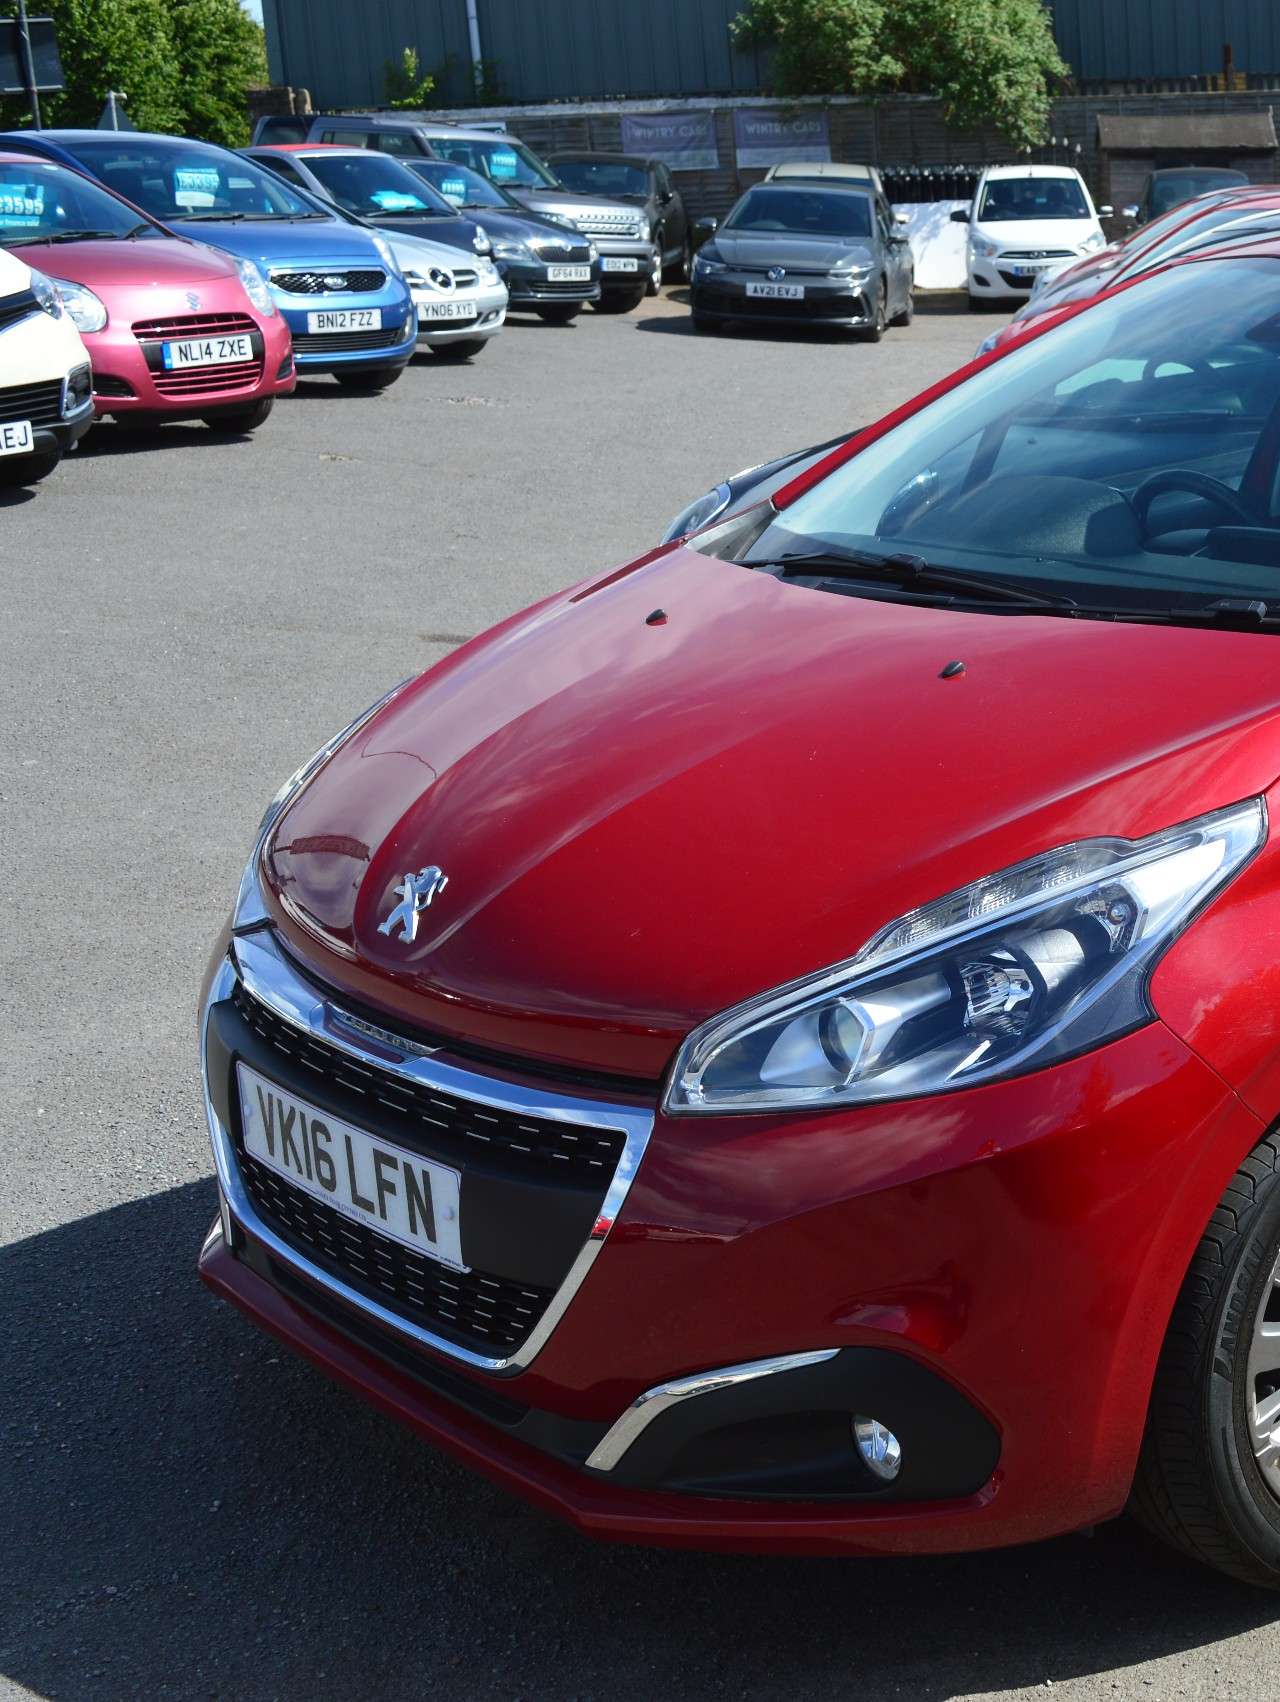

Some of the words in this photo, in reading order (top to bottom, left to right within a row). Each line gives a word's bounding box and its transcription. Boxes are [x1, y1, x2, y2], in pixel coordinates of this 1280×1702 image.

[752, 284, 776, 296] AV21
[777, 286, 798, 297] EVJ
[317, 313, 346, 329] BN12
[349, 311, 373, 327] FZZ
[423, 303, 454, 317] YN06
[456, 302, 473, 315] XYD
[178, 342, 213, 362] NL14
[217, 338, 247, 358] ZXE
[0, 425, 28, 450] EJ
[256, 1085, 337, 1193] VK16
[345, 1134, 437, 1244] LFN
